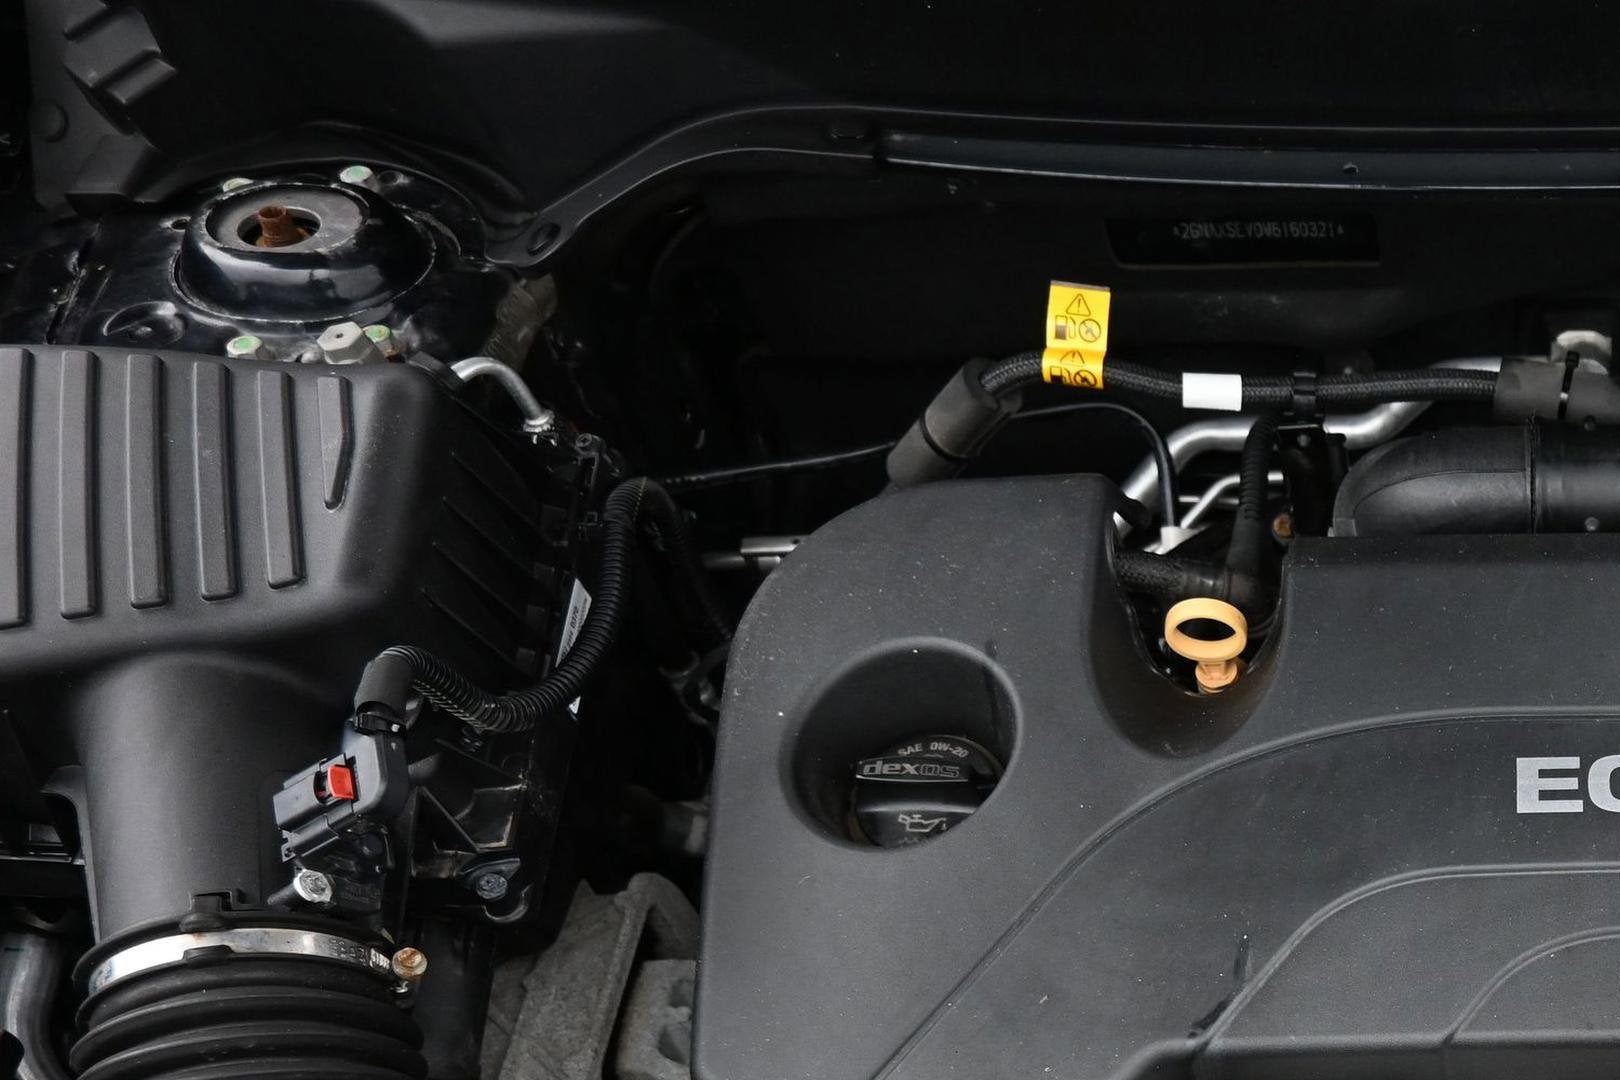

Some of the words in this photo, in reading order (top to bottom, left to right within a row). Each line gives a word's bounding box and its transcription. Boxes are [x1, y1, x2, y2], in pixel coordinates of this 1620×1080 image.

[897, 743, 923, 756] SAE
[930, 741, 969, 758] 0W-20
[863, 760, 960, 777] dexos
